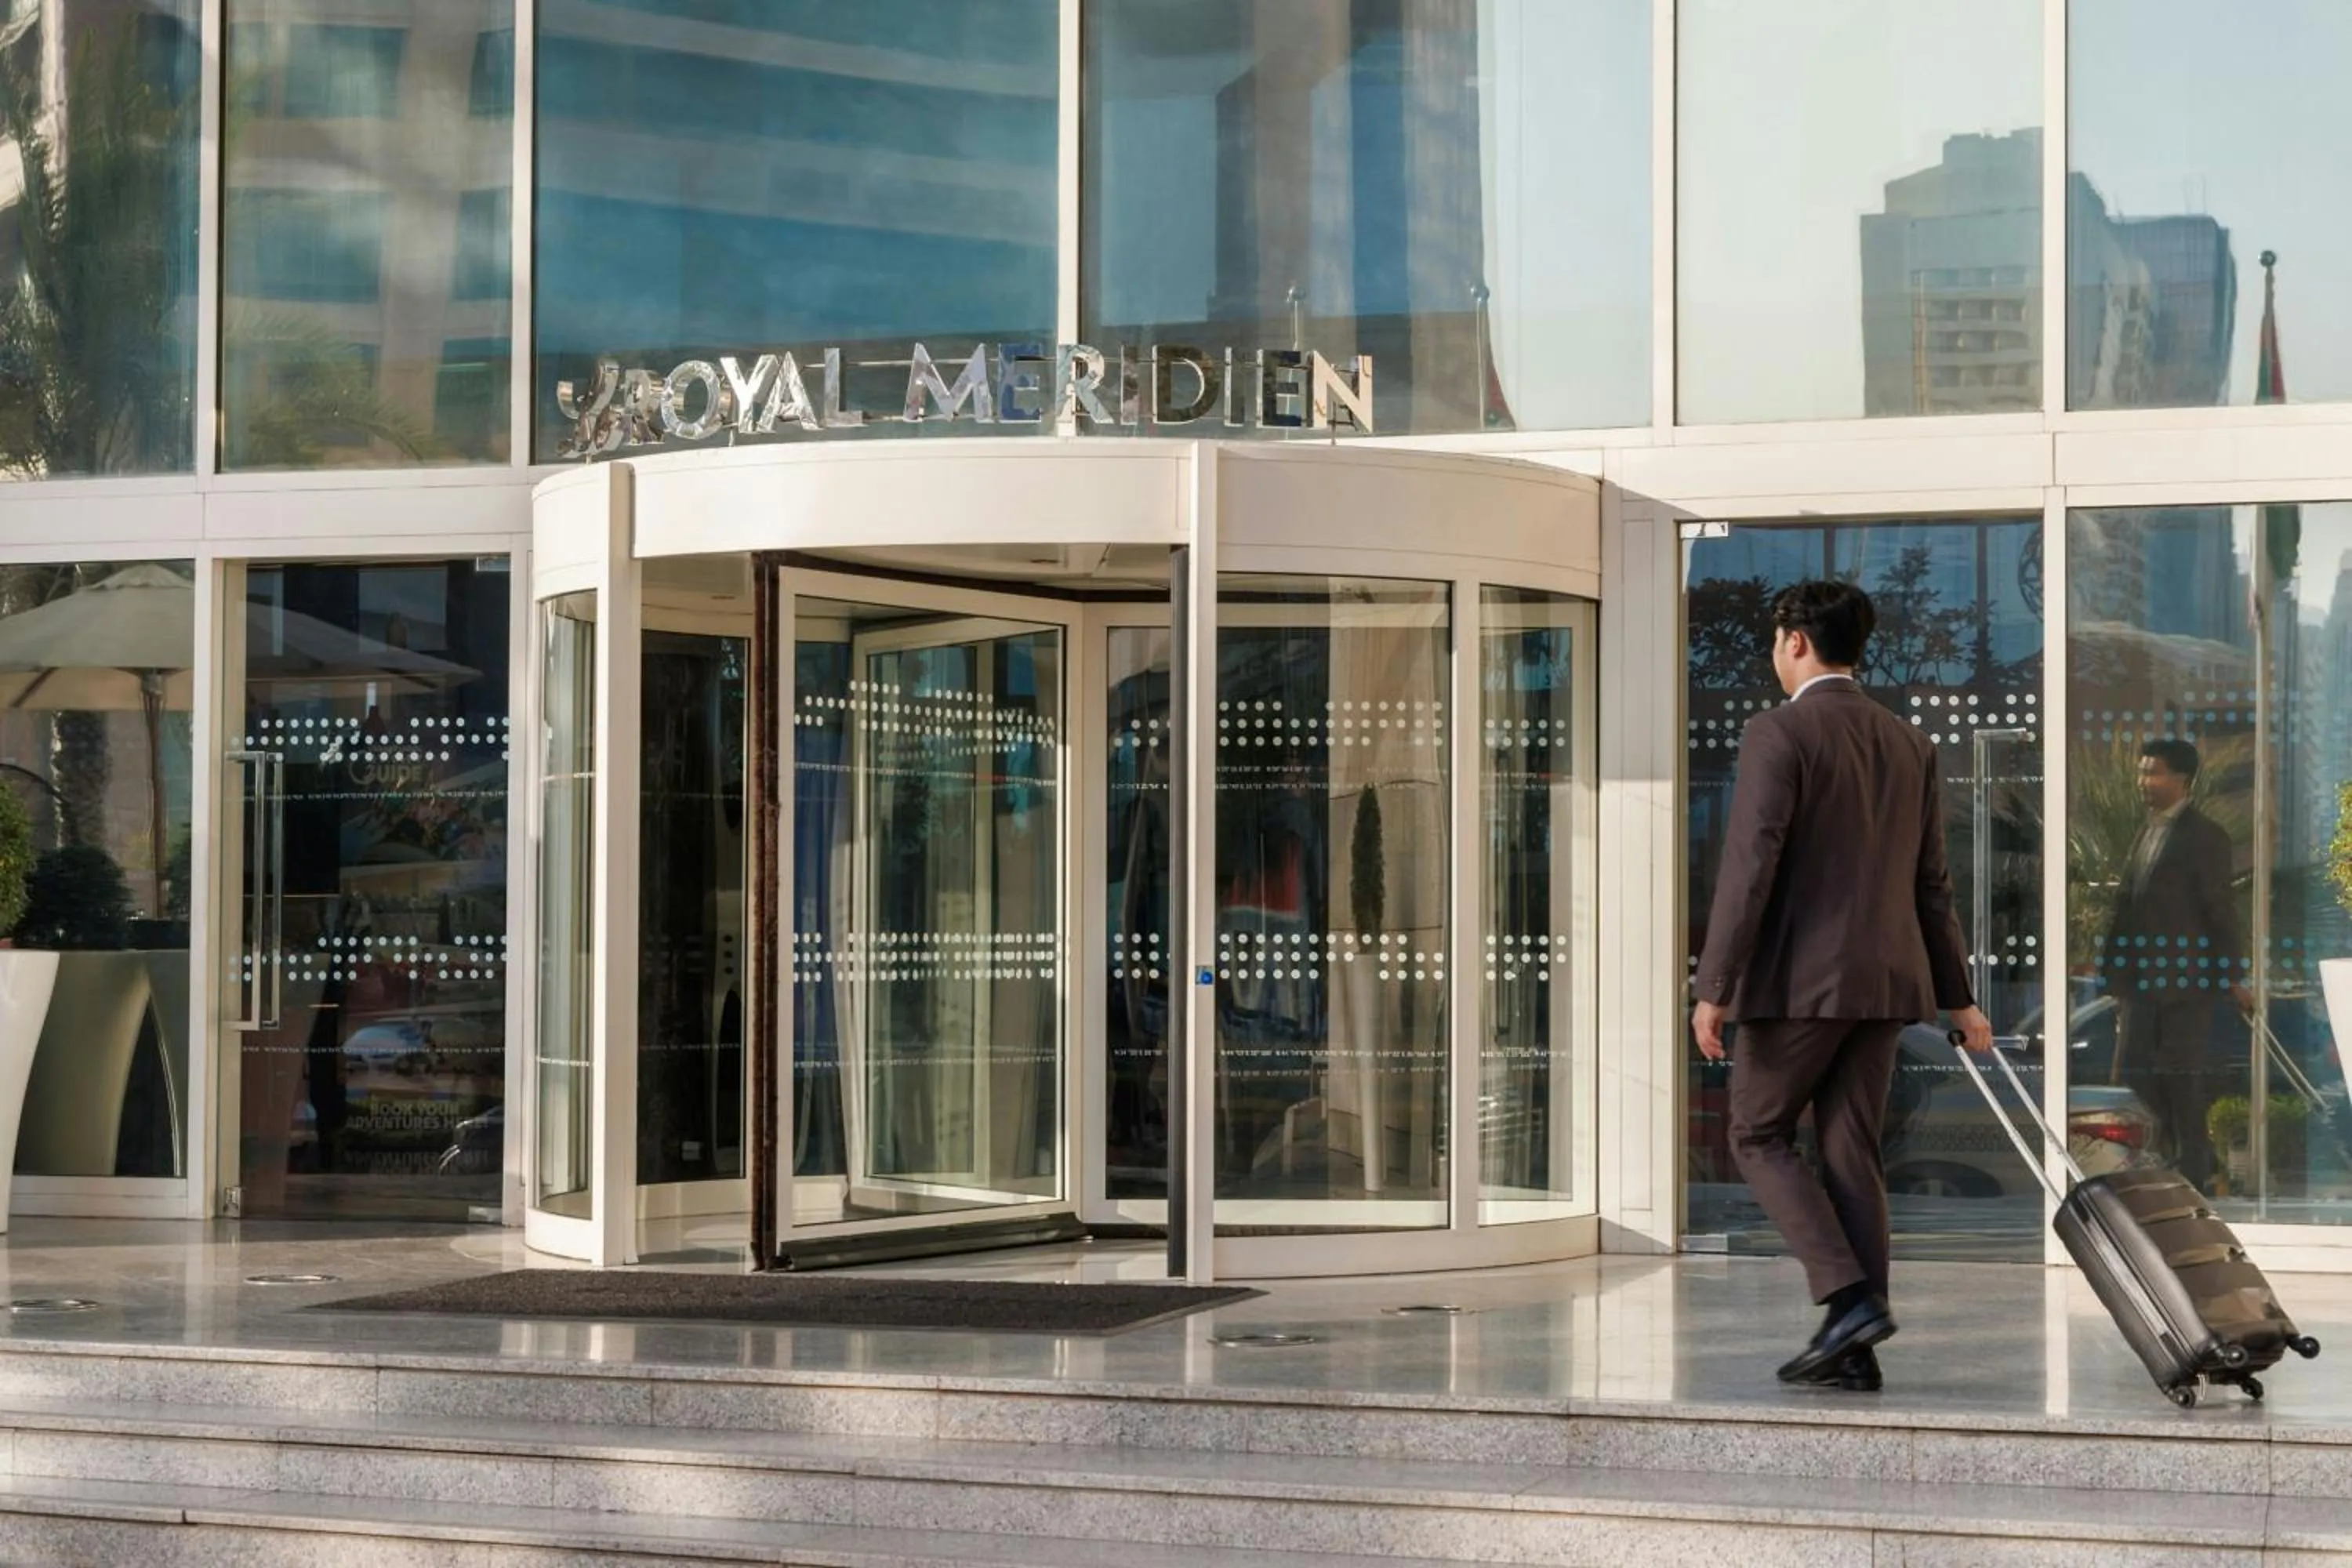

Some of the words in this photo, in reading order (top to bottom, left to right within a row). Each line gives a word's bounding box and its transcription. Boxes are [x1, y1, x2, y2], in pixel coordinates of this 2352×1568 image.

[623, 347, 869, 445] ROYAL
[902, 343, 1373, 432] MERIDIEN
[371, 1102, 413, 1116] BOOK
[417, 1102, 459, 1116] YOUR
[346, 1116, 440, 1130] ADVENTURES
